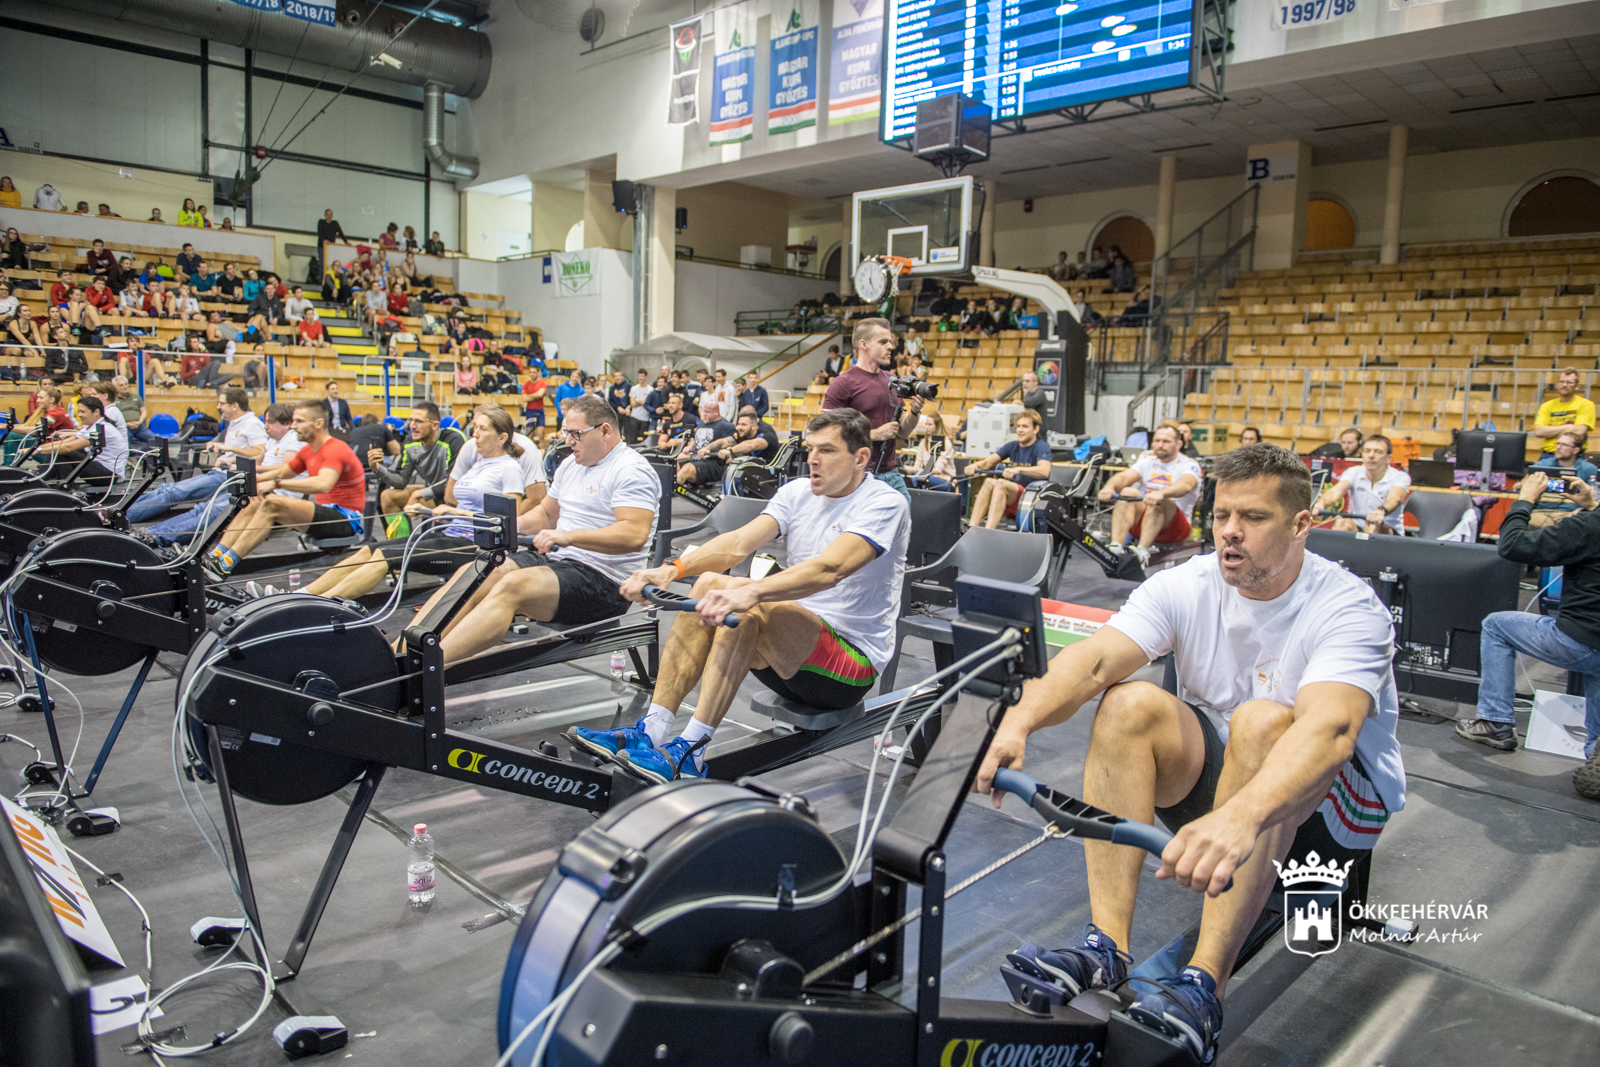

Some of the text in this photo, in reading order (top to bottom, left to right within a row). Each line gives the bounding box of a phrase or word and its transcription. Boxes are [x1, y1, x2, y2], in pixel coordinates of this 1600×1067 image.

[286, 1, 335, 23] 2018/19
[1281, 0, 1355, 25] 1997/98
[841, 42, 878, 62] MAGYAR
[778, 56, 808, 76] MAGYAR
[847, 60, 871, 76] KUPA
[782, 71, 802, 88] KUPA
[839, 74, 878, 93] GYŐZTES
[775, 86, 808, 105] GYŐZTES
[1248, 158, 1270, 180] B
[484, 760, 600, 799] concept 2
[980, 1042, 1095, 1067] concept 2
